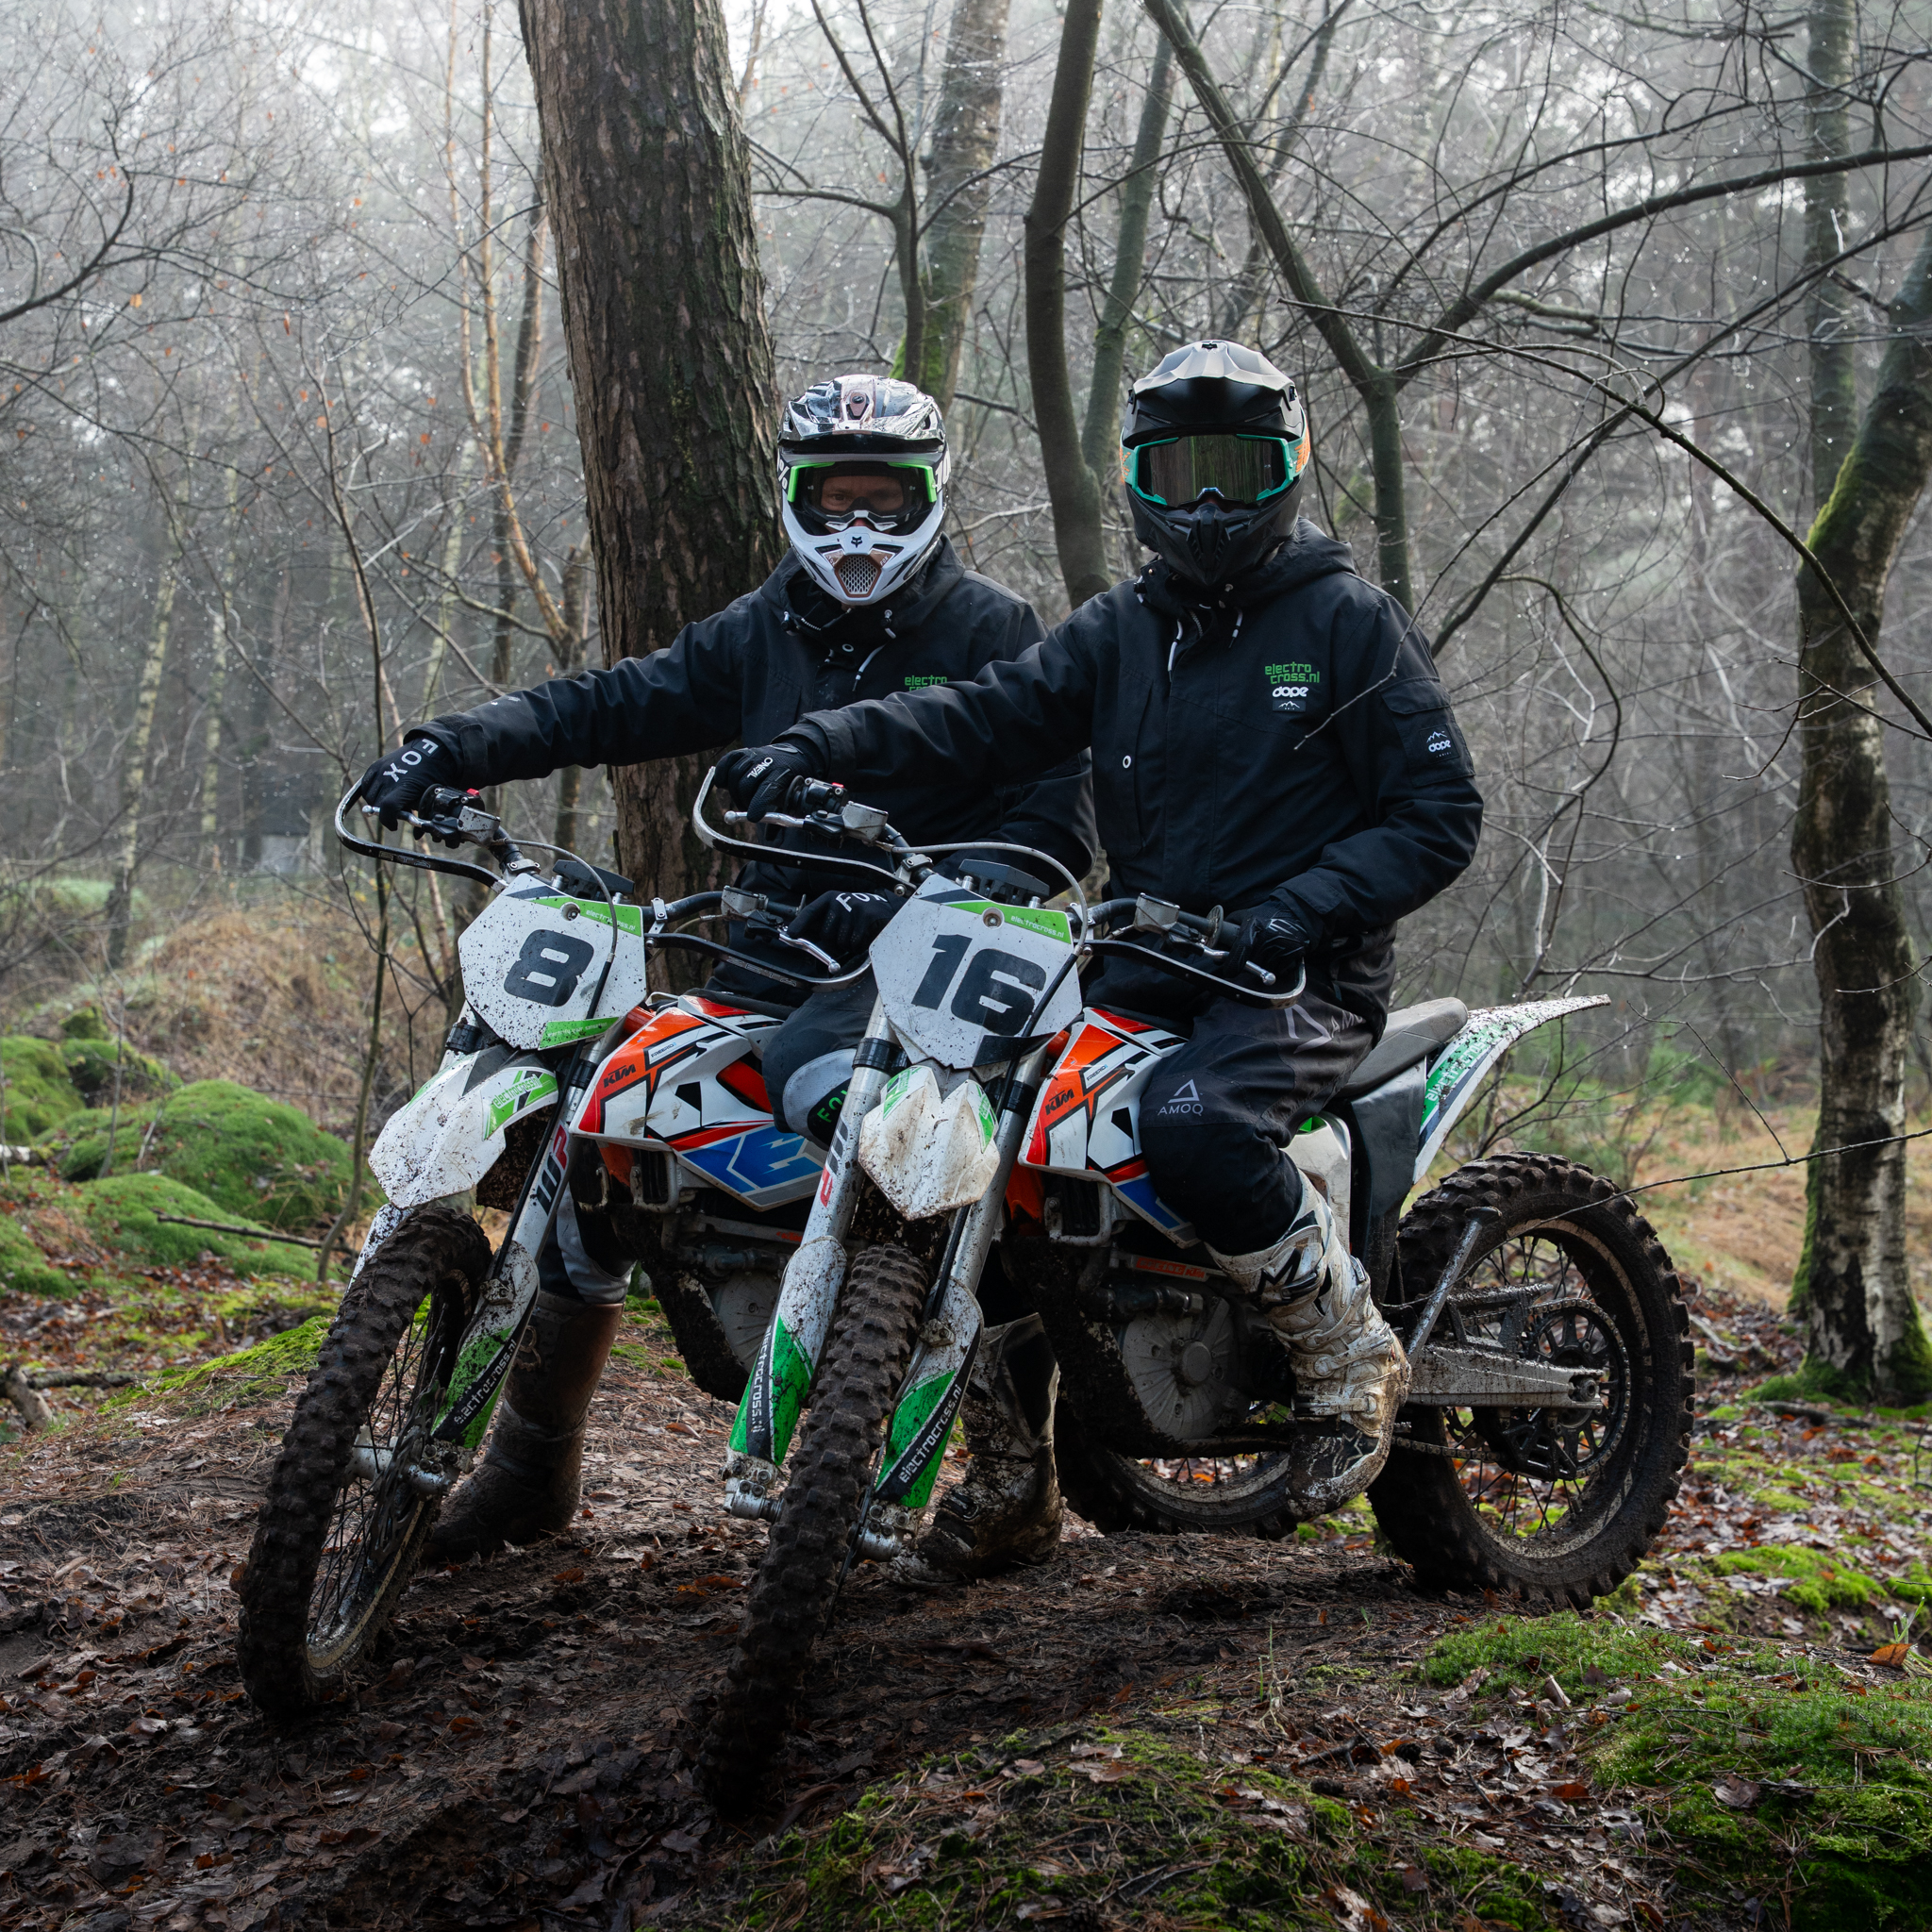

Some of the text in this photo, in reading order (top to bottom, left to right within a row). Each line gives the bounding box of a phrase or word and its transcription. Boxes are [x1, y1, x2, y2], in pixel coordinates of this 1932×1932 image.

[1265, 661, 1311, 675] electro
[904, 675, 948, 687] electro
[1270, 671, 1320, 685] cross.nl
[1272, 686, 1309, 698] dope
[1428, 739, 1452, 753] dope
[383, 739, 439, 783] FOX
[1010, 914, 1065, 940] electrocross.nl
[504, 929, 594, 1008] 8
[911, 934, 1046, 1037] 16
[604, 1064, 636, 1088] KTM
[1045, 1089, 1074, 1116] KTM
[1158, 1104, 1204, 1117] AMOQ
